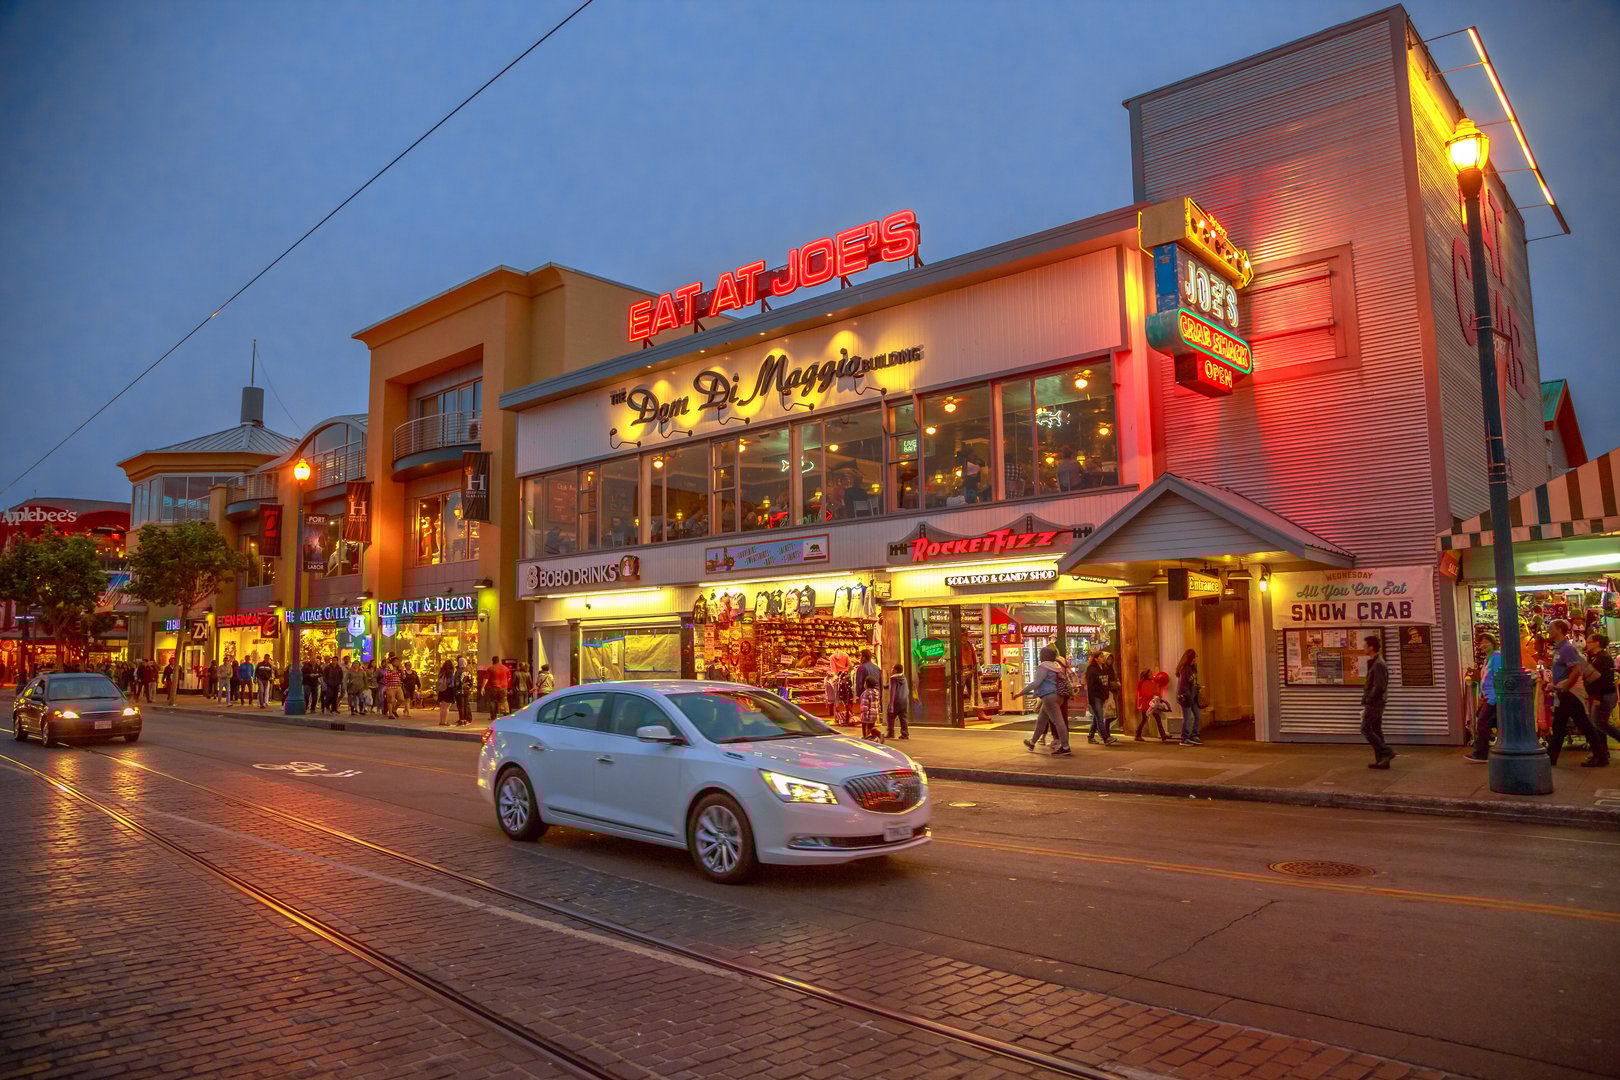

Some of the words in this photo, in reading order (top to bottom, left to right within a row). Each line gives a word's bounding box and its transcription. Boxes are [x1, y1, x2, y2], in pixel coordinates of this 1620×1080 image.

[628, 282, 703, 342] EAT
[708, 260, 766, 317] AT
[771, 209, 917, 296] JOE'S
[1184, 260, 1239, 328] JOE'S
[1180, 315, 1212, 347] CRAB
[1213, 333, 1249, 367] SHACK
[1204, 360, 1233, 388] OPEN
[609, 389, 627, 406] THE
[626, 388, 690, 426] Dom
[861, 347, 922, 373] BUILDING
[466, 474, 486, 490] H
[1, 507, 78, 525] Applebee's
[349, 501, 367, 516] H
[540, 569, 571, 587] BOBO
[572, 564, 617, 585] DRINKS
[947, 577, 970, 585] SODA
[971, 576, 990, 584] POP
[990, 575, 997, 583] &
[999, 572, 1029, 582] CANDY
[1030, 570, 1055, 580] SHOP
[1189, 576, 1219, 592] Entrance
[1325, 571, 1373, 581] WEDNESDAY
[1296, 584, 1319, 598] All
[1320, 584, 1350, 600] You
[1352, 582, 1379, 597] Can
[1382, 580, 1407, 596] Eat
[378, 602, 398, 616] FINE
[401, 600, 420, 614] ART
[423, 597, 432, 612] &
[435, 596, 473, 611] DECOR
[1291, 602, 1346, 621] SNOW
[1357, 600, 1412, 620] CRAB
